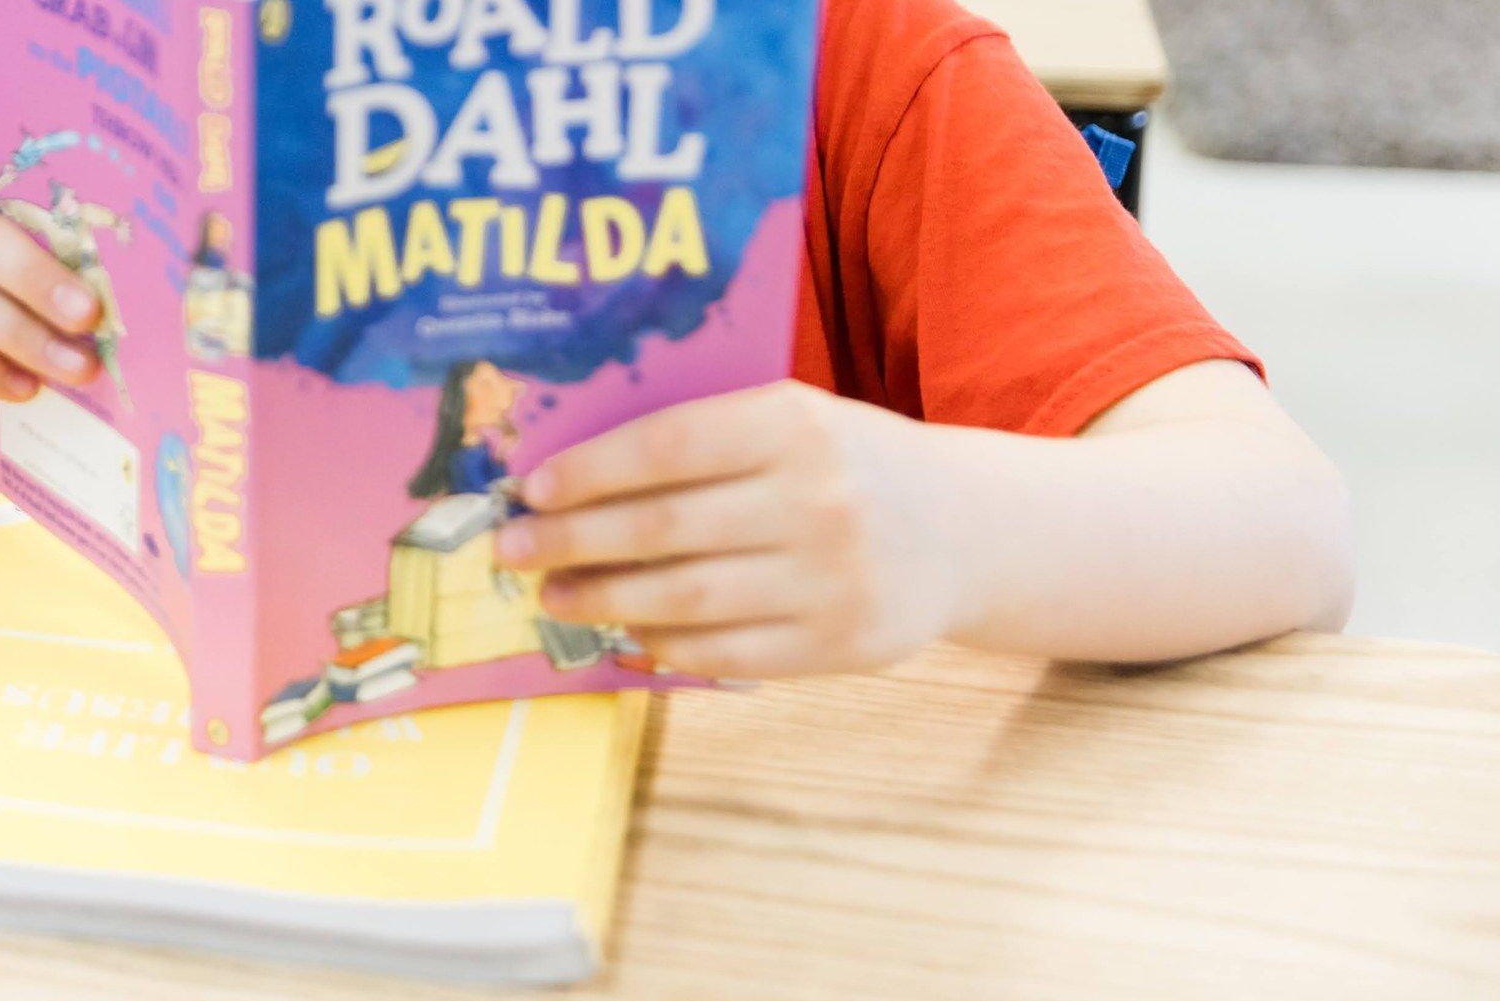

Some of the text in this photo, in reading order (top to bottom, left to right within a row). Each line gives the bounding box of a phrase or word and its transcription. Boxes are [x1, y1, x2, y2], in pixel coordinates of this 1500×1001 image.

[325, 62, 706, 206] DAHL
[315, 188, 707, 316] MATILDA
[190, 369, 248, 573] MATILDA
